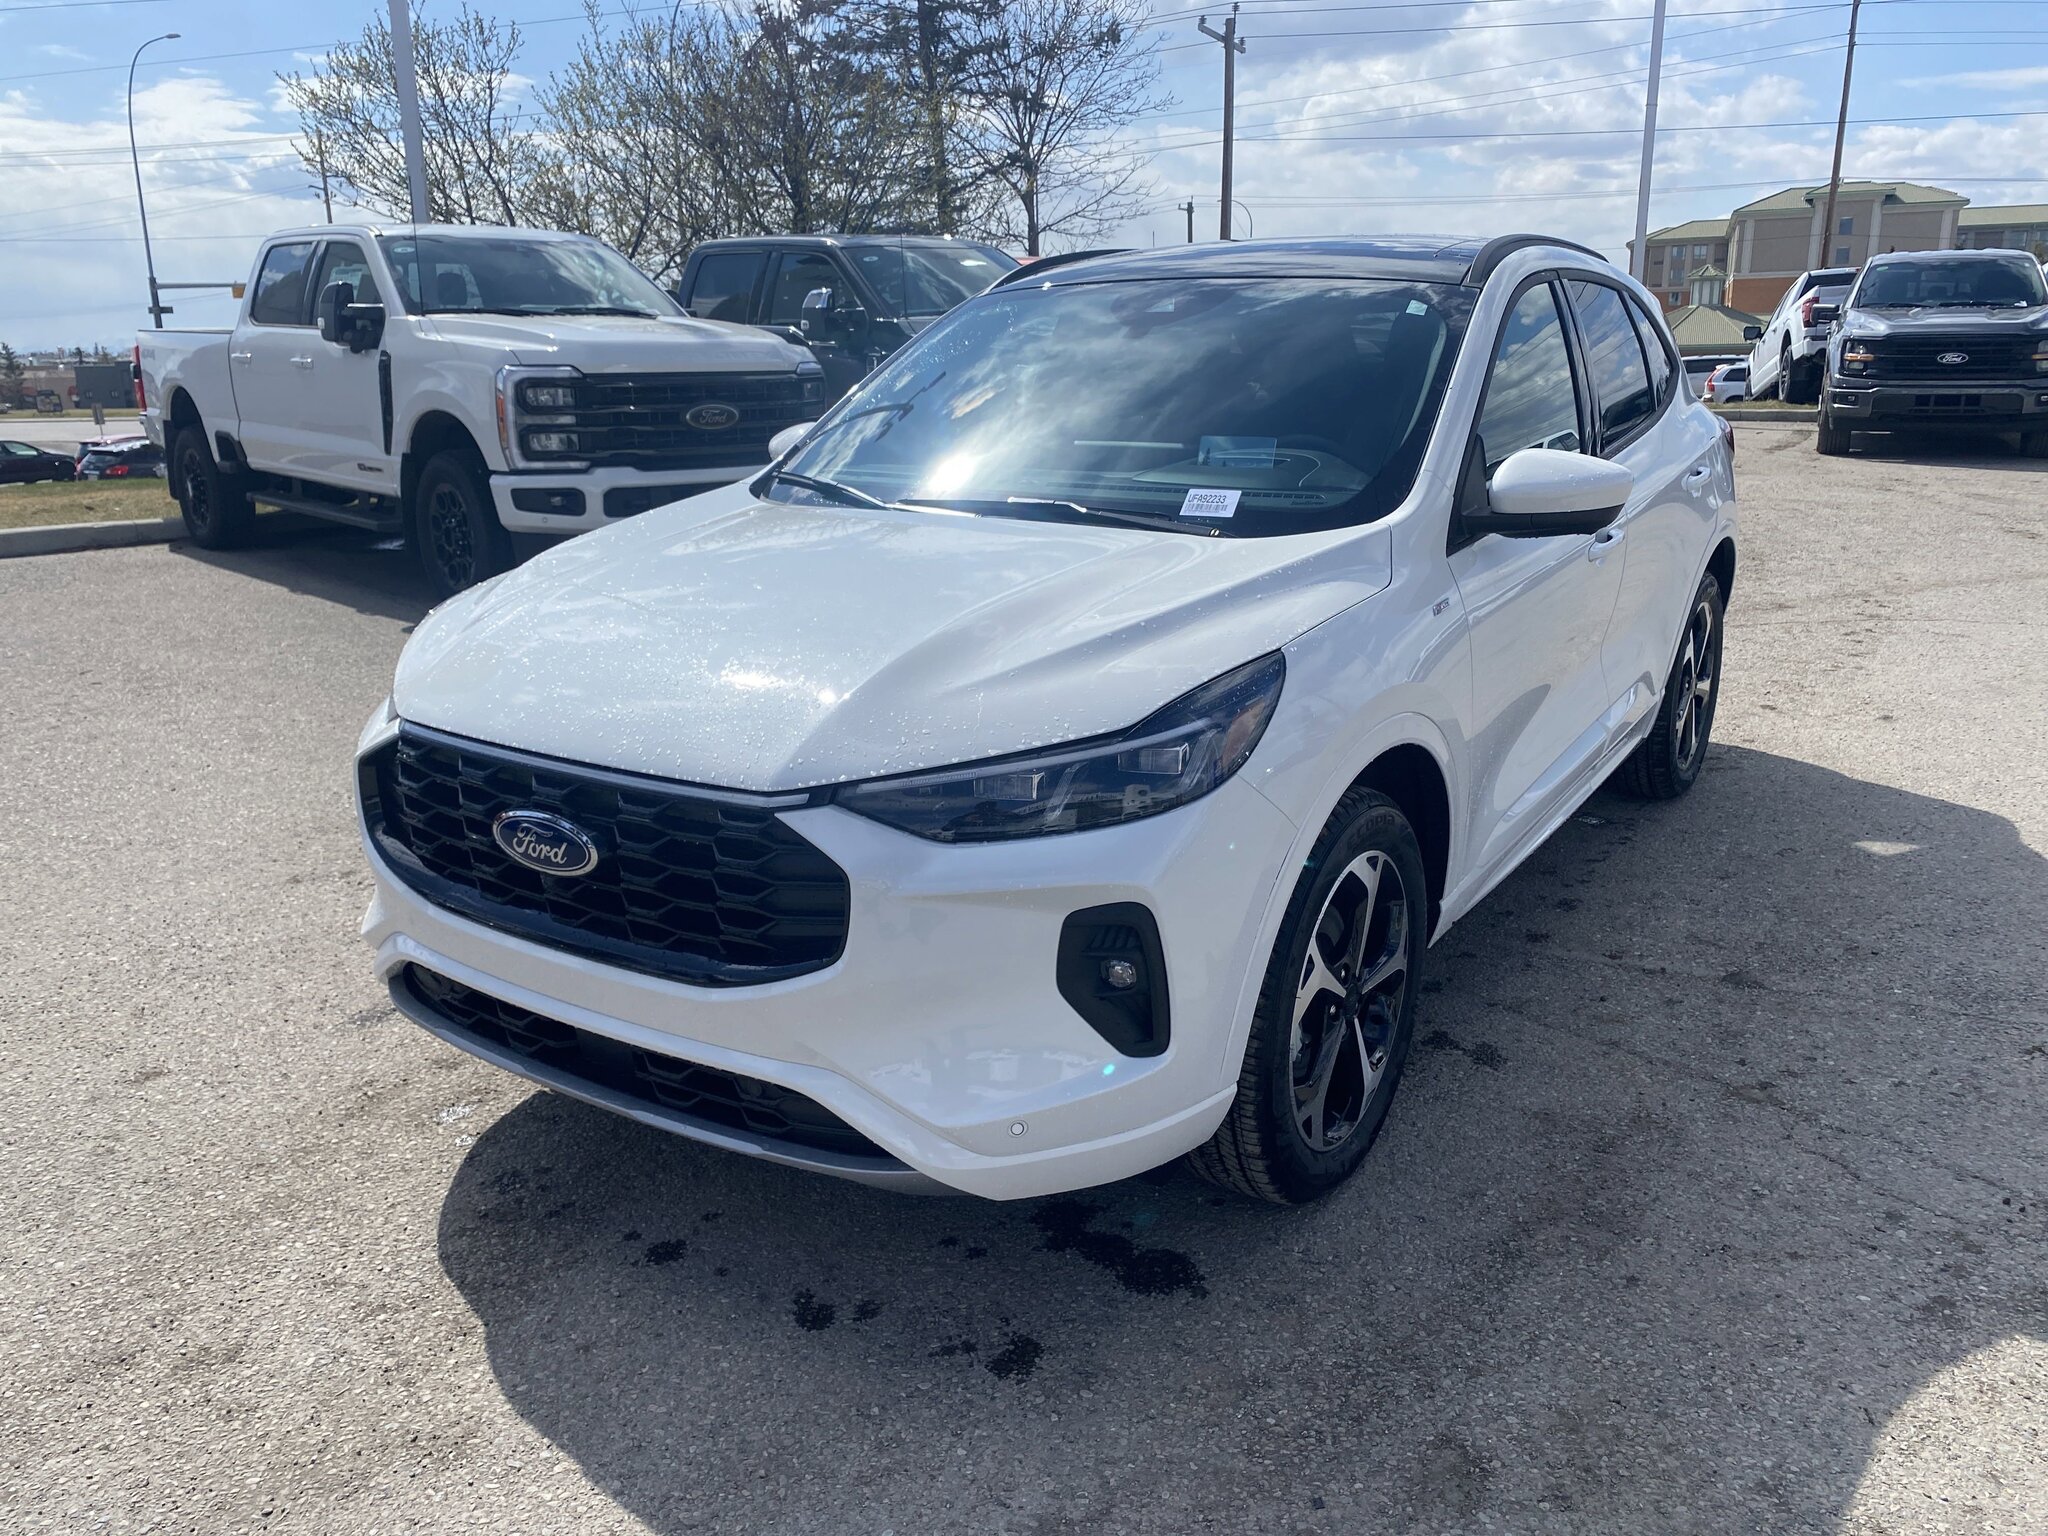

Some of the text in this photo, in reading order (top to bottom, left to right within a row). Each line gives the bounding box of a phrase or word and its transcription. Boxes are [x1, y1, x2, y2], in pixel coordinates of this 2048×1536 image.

[700, 409, 728, 423] Ford
[1187, 494, 1227, 504] UFA92233
[512, 822, 568, 864] Ford
